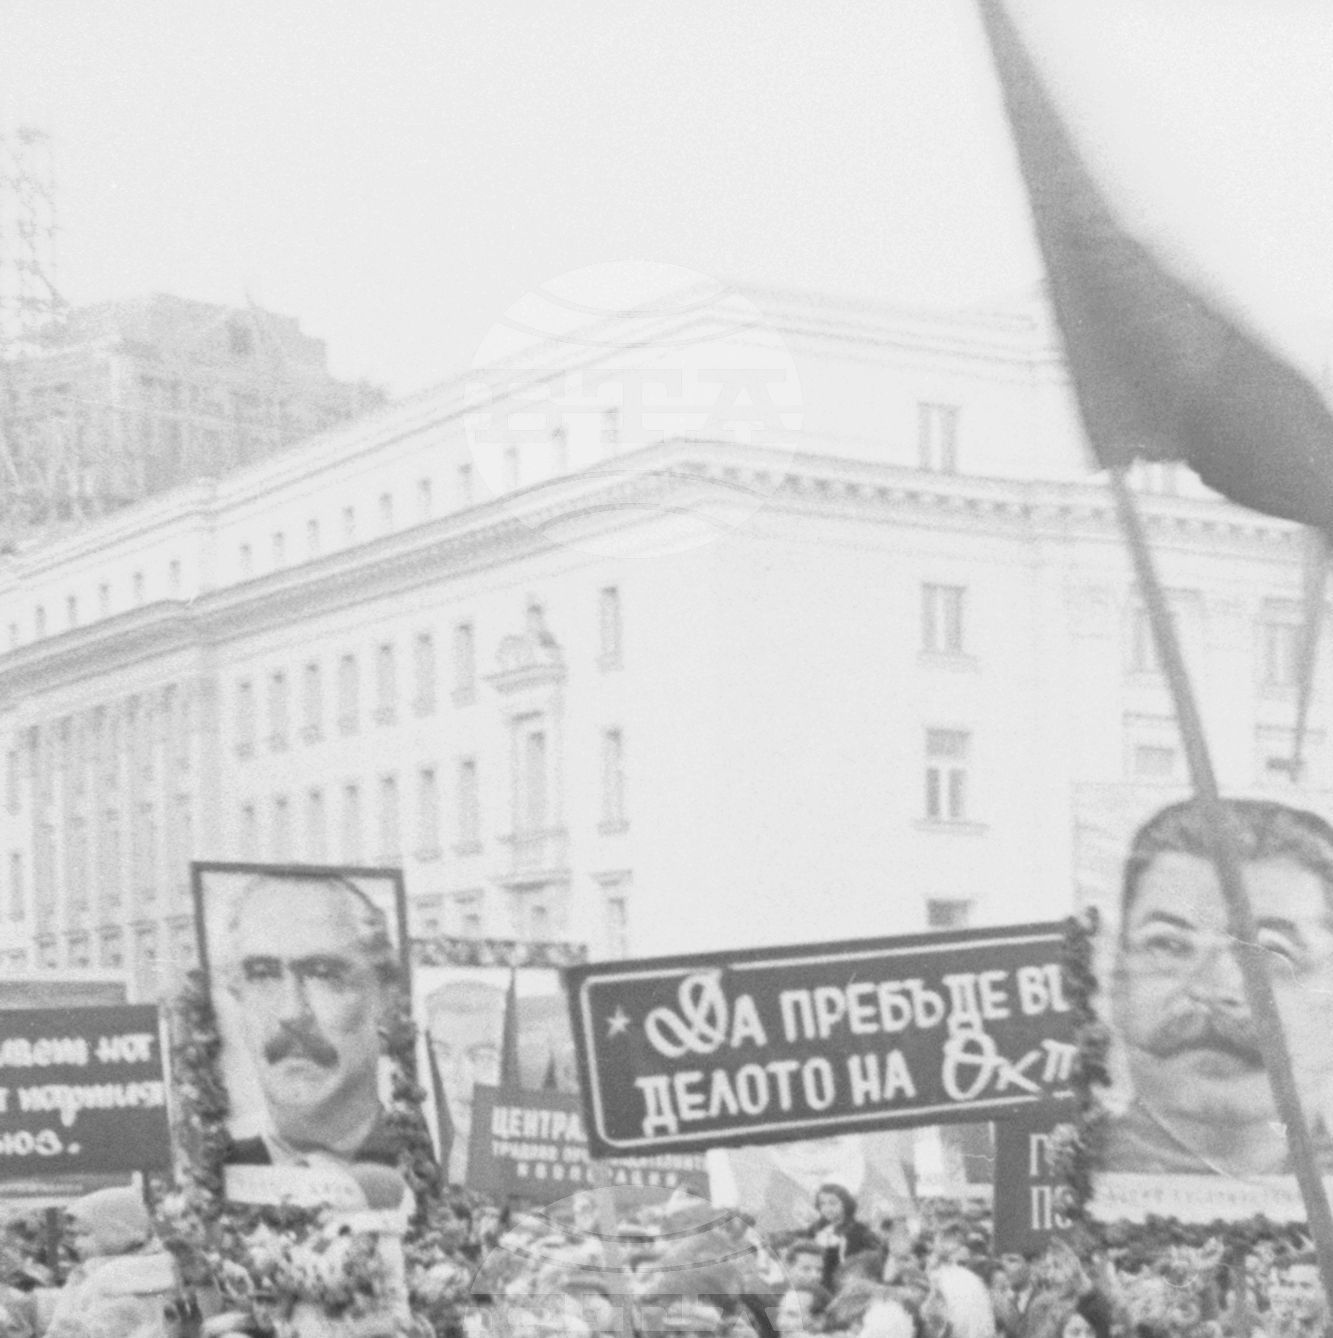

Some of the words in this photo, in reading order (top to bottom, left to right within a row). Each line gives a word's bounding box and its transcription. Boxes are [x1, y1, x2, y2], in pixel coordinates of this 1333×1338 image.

[780, 968, 1010, 1042] ПРЕБЪДЕ
[491, 1105, 589, 1143] ЦЕНТРА
[634, 1056, 835, 1137] ДЕЛОТО
[848, 1050, 917, 1106] НА
